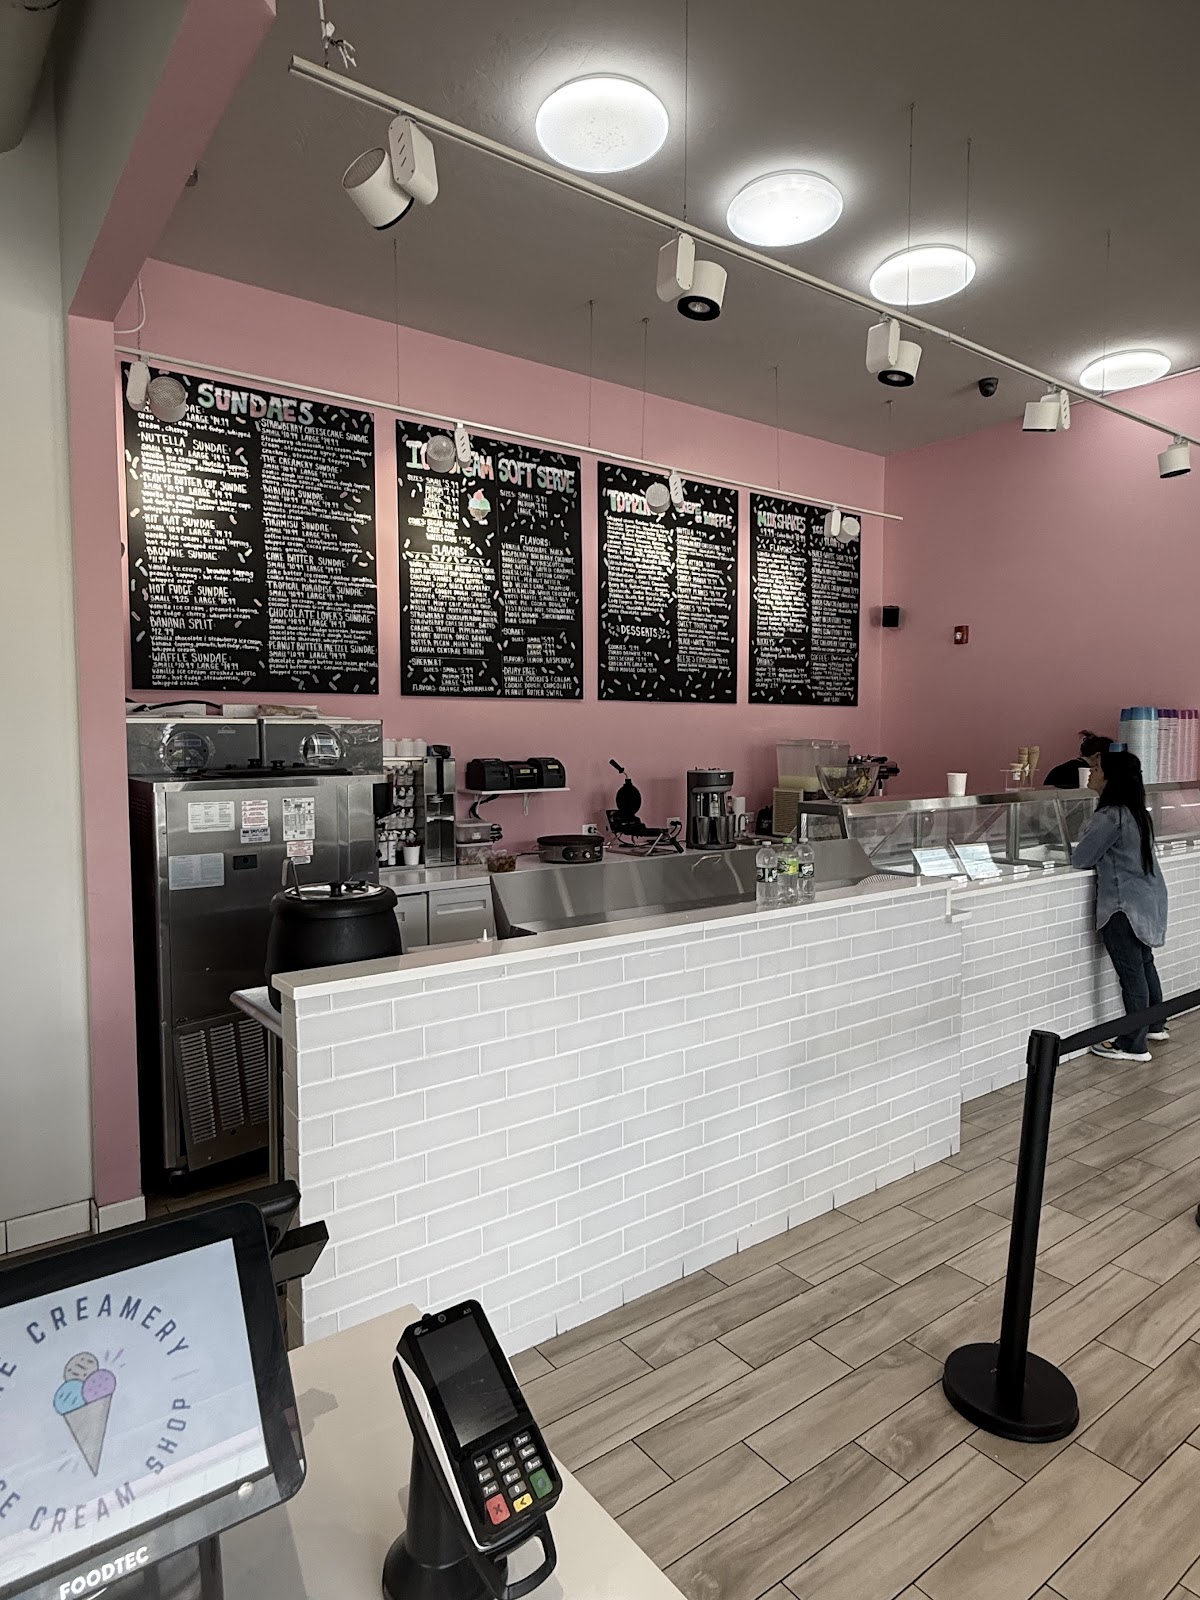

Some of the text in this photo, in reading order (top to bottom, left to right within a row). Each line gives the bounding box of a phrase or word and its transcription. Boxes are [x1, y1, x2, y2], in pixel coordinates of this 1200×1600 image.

[198, 383, 314, 425] SUNDAES
[186, 413, 209, 424] LARGE
[261, 418, 303, 434] STRAWBERRY
[304, 426, 344, 440] CHEESECAKE
[262, 428, 280, 438] SMALL
[301, 434, 320, 443] LARGE
[141, 432, 231, 455] NUTELLA SUNDAE:
[141, 443, 161, 453] SMALL
[188, 450, 209, 460] LARGE
[262, 454, 276, 463] THE
[278, 456, 313, 469] CREAMERY
[143, 471, 172, 482] PEANUT
[175, 475, 202, 488] BUTTER
[204, 479, 217, 489] CUP
[498, 458, 537, 488] SOFT
[537, 466, 575, 493] SERVE
[143, 482, 162, 492] SMALL
[189, 488, 211, 497] LARGE
[263, 484, 295, 497] BAKLAVA
[518, 492, 533, 500] SMALL
[144, 514, 159, 523] KIT
[163, 515, 180, 525] KAT
[263, 518, 298, 529] TIRAMISU
[703, 511, 733, 529] WAFFLE
[757, 511, 806, 534] MILKSHAKES
[189, 528, 212, 537] LARGE
[520, 534, 551, 546] FLAVORS:
[146, 546, 185, 558] BROWNIE
[432, 545, 467, 557] FLAVORS:
[266, 552, 284, 561] CAKE
[286, 554, 314, 565] BATTER
[148, 583, 231, 598] HOT FUDGE SUNDAE:
[266, 581, 299, 591] TROPICAL
[302, 584, 333, 594] PARADISE
[269, 590, 287, 598] SMALL
[194, 596, 217, 604] LARGE
[268, 608, 315, 619] CHOCOLATE
[150, 617, 186, 629] BANANA
[269, 641, 295, 650] PEANUT
[296, 641, 322, 652] BUTTER
[324, 643, 348, 653] PRETZEL
[152, 653, 188, 662] WAFFLE
[504, 667, 521, 675] DAIRY
[26, 1294, 189, 1356] CREAMERY
[146, 1397, 191, 1474] SHOP
[29, 1481, 136, 1534] CREAM
[59, 1546, 150, 1600] FOODTEC
